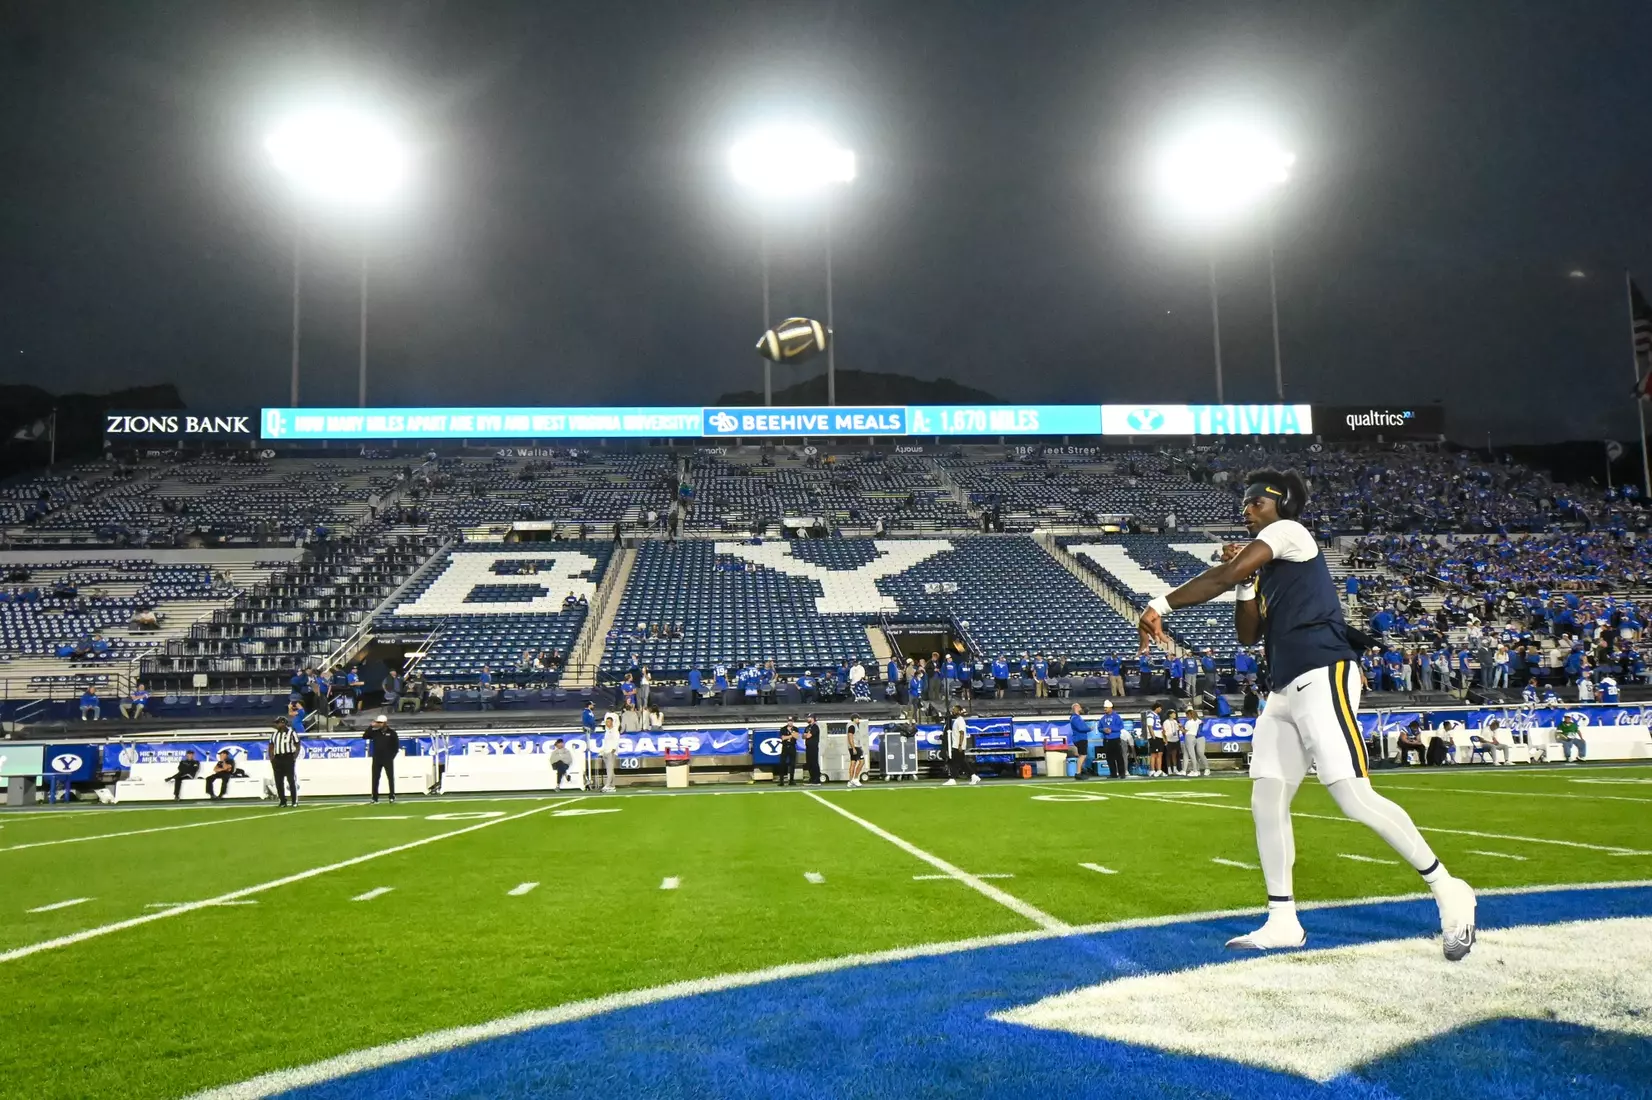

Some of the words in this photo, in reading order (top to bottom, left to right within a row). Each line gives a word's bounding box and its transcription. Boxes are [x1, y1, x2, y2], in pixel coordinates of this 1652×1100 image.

[107, 416, 178, 433] ZIONS
[185, 416, 249, 433] BANK
[266, 409, 287, 438] Q:
[366, 415, 405, 432] MILES
[406, 415, 447, 432] APART
[532, 415, 565, 432] WEST
[742, 415, 827, 431] BEEHIVE
[835, 414, 901, 430] MEALS
[940, 409, 987, 434] 1,670
[989, 410, 1039, 431] MILES
[1187, 405, 1301, 434] TRIVIA
[1346, 410, 1404, 430] qualtrics
[467, 740, 534, 755] BYU
[1223, 742, 1239, 753] 40
[621, 757, 640, 769] 40
